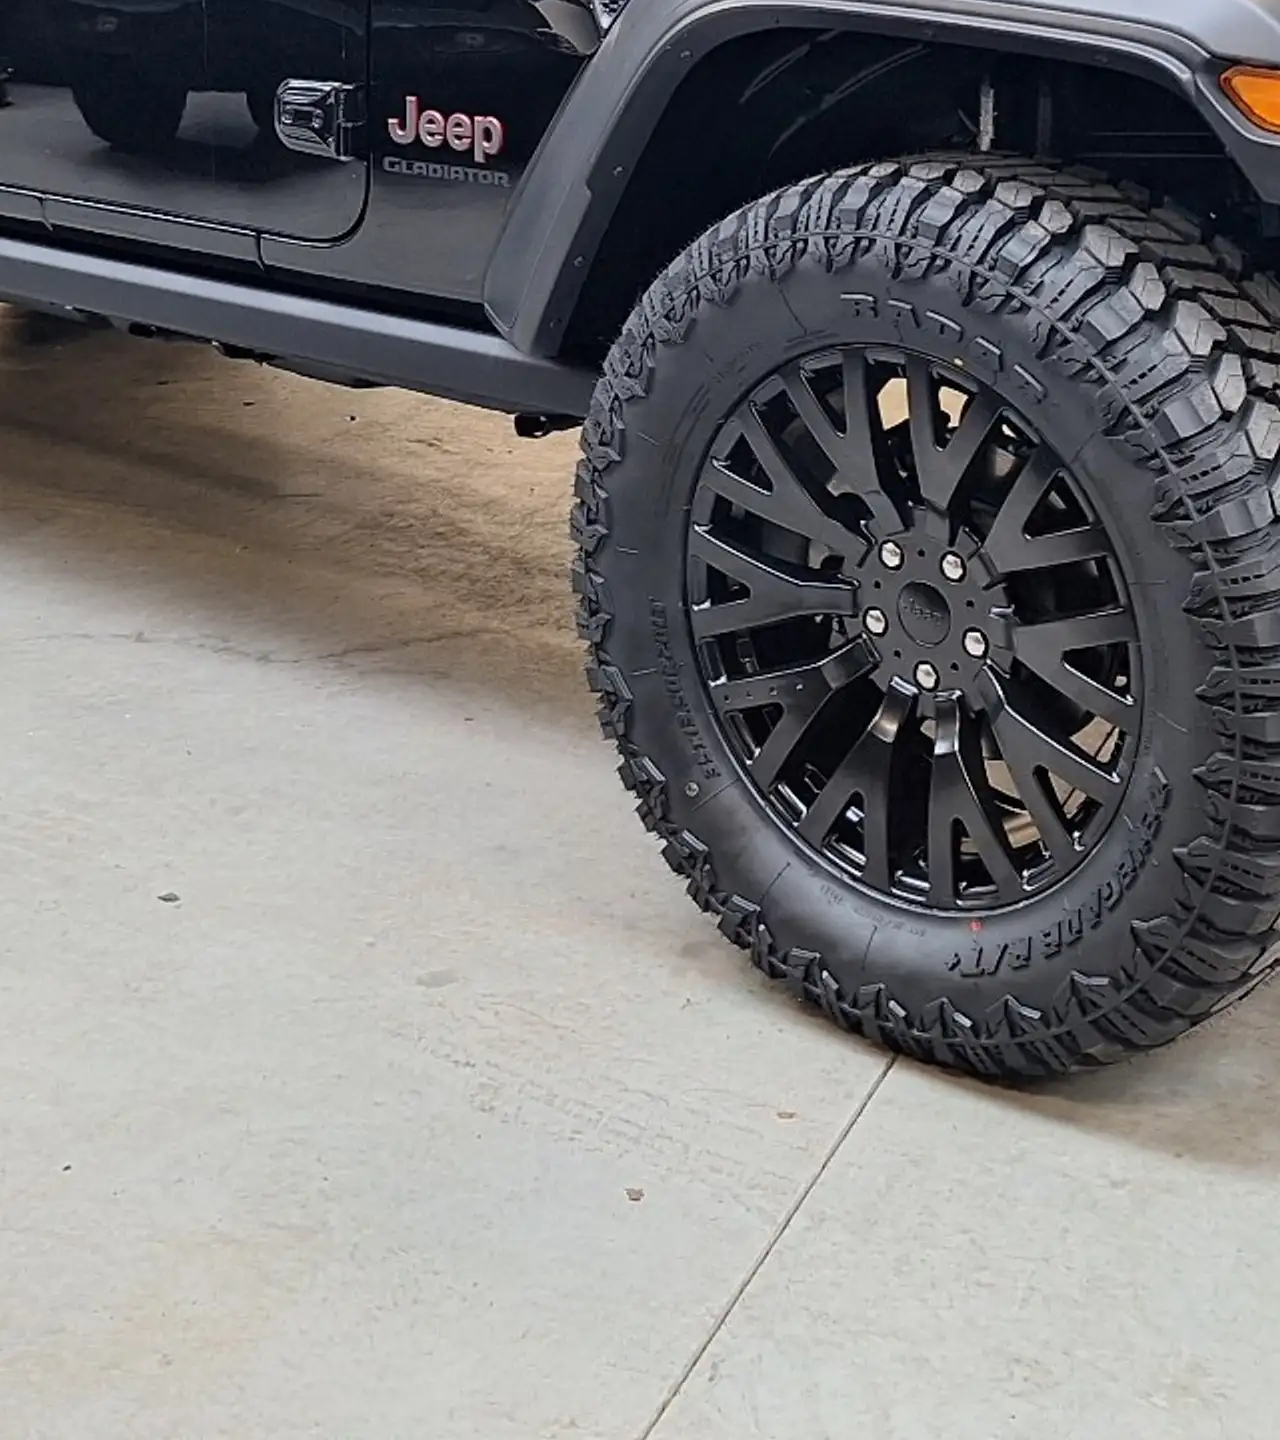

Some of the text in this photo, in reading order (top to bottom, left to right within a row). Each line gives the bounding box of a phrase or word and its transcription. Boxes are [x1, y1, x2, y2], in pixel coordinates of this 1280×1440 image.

[387, 95, 504, 163] Jeep
[382, 156, 512, 188] GLADIATOR
[838, 291, 1049, 406] RADAR
